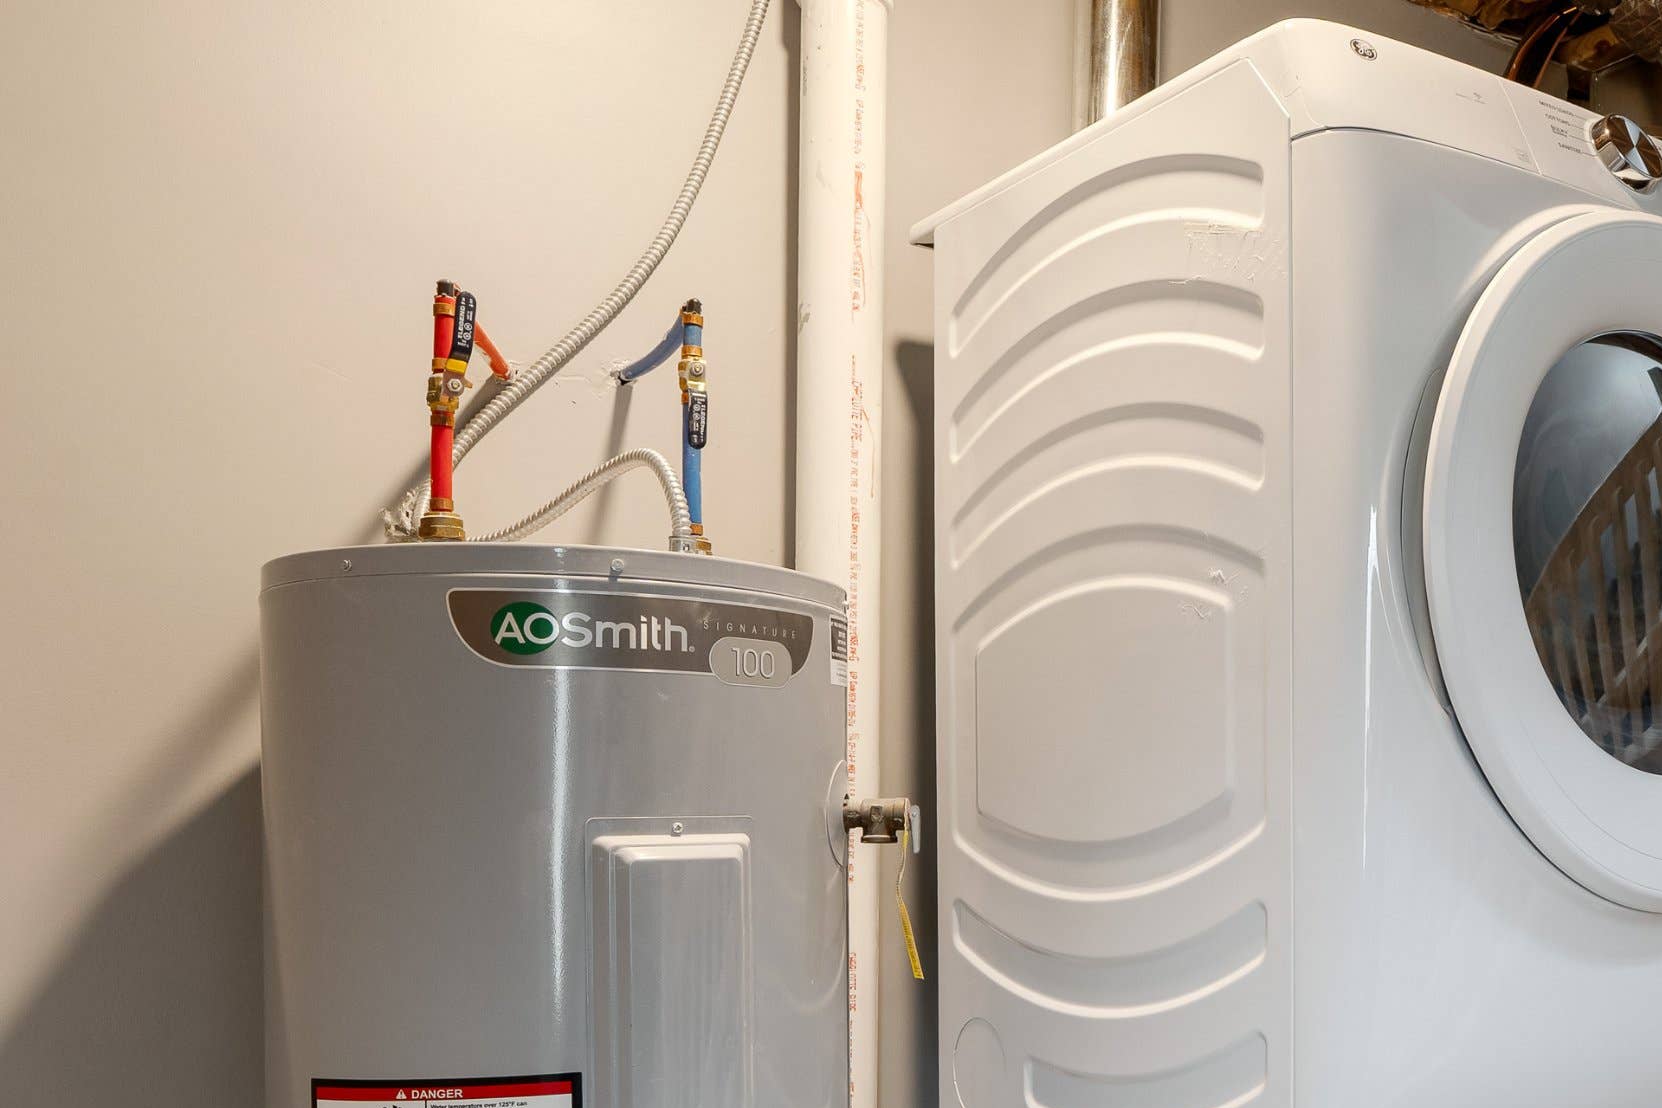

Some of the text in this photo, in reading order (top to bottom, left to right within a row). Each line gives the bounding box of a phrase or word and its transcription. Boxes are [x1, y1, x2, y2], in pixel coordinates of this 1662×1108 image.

[495, 612, 688, 652] AOSmith
[703, 620, 798, 640] SIGNATURE
[730, 647, 775, 679] 100
[412, 1088, 463, 1099] DANGER
